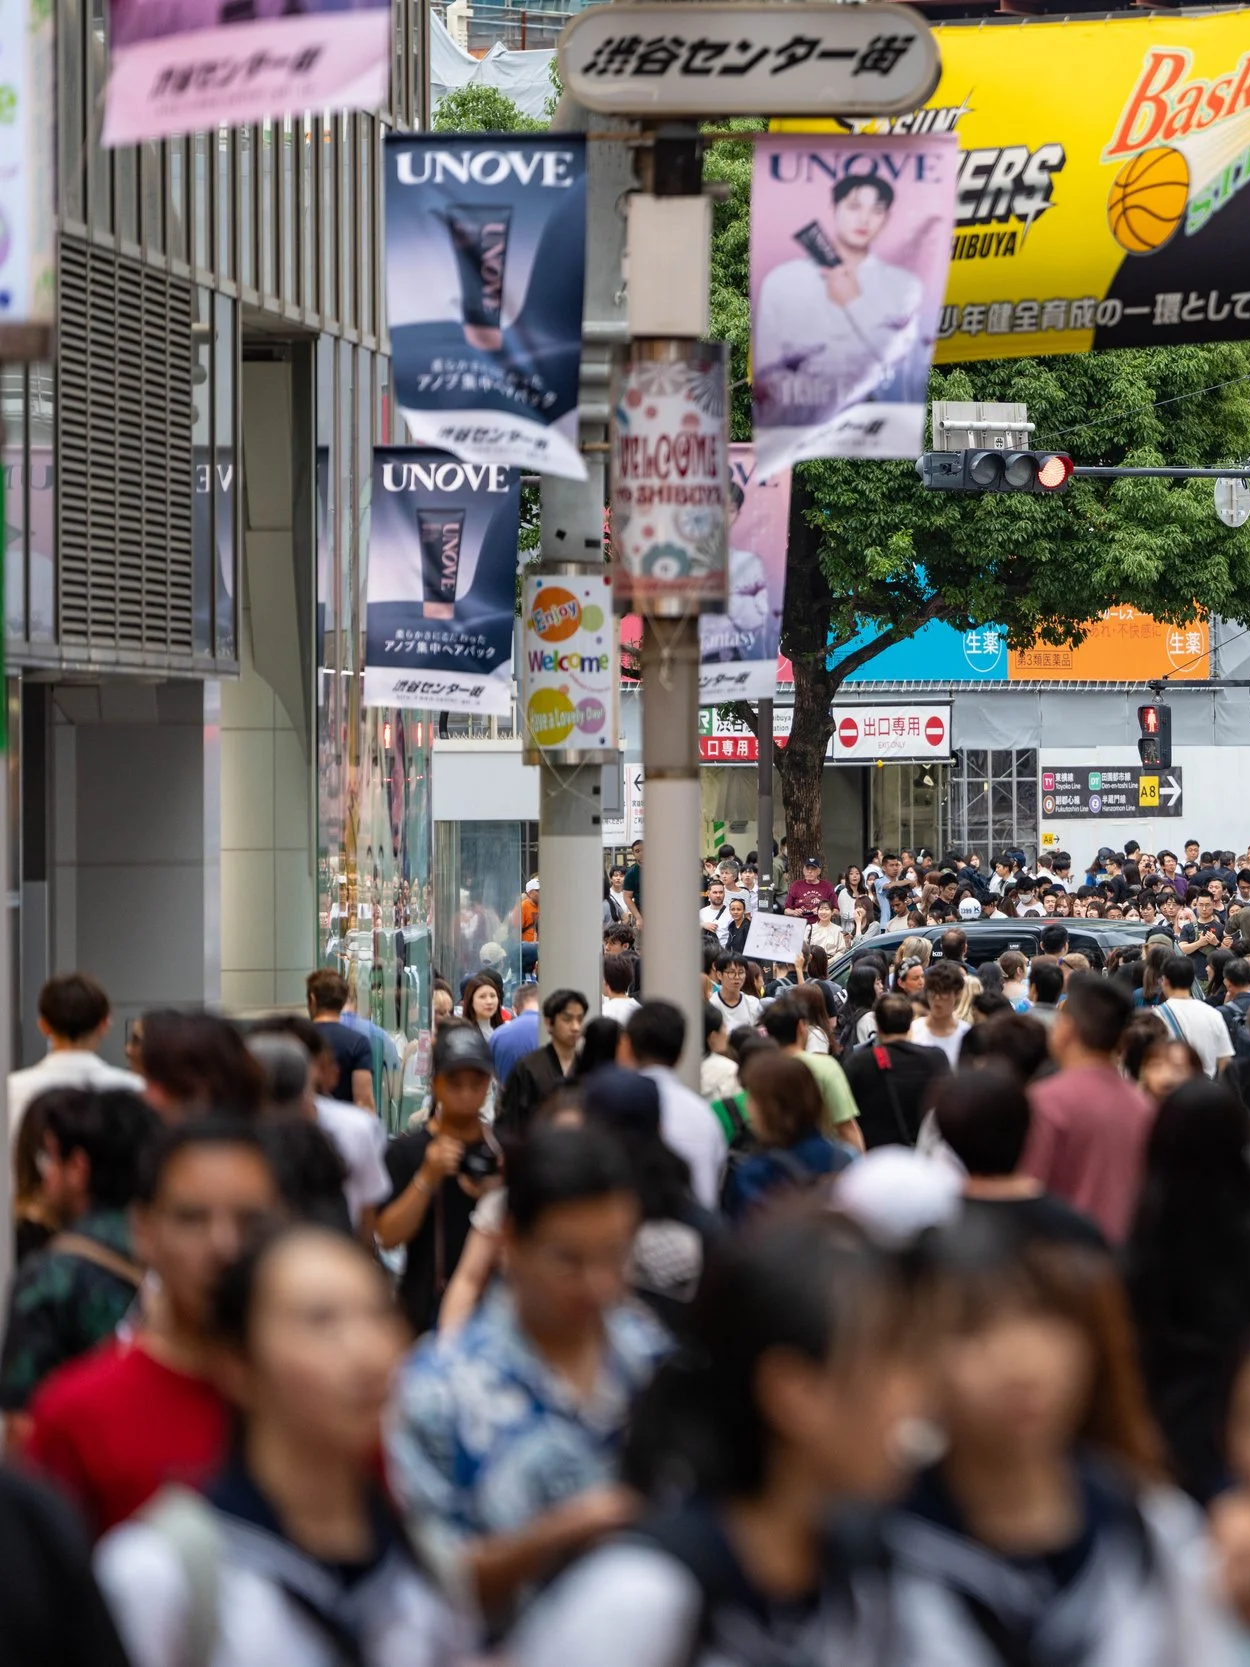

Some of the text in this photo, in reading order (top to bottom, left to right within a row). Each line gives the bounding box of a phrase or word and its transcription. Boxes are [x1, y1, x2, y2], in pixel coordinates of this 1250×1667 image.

[582, 33, 917, 78] 渋谷センター街
[396, 151, 574, 187] UNOVE
[768, 151, 945, 184] UNOVE
[957, 143, 1066, 224] ERS
[382, 462, 510, 493] UNOVE
[441, 523, 459, 593] UNOVE
[533, 600, 577, 633] Enjoy
[966, 632, 999, 655] 生薬
[1169, 632, 1201, 655] 生薬
[528, 649, 609, 673] Welcome
[1017, 652, 1072, 668] 第3類医薬品
[392, 680, 486, 698] 渋谷センター街
[863, 716, 921, 737] 出口専用
[1044, 777, 1053, 785] TY
[1055, 773, 1074, 782] 東横線
[1090, 777, 1099, 785] DT
[1101, 772, 1132, 782] 田園都市線
[1055, 796, 1080, 805] 副都心線
[1102, 795, 1126, 804] 半蔵門線
[1141, 785, 1156, 798] A8
[1055, 804, 1089, 812] Fukutoshin Line
[1102, 804, 1126, 812] Hanzomon
